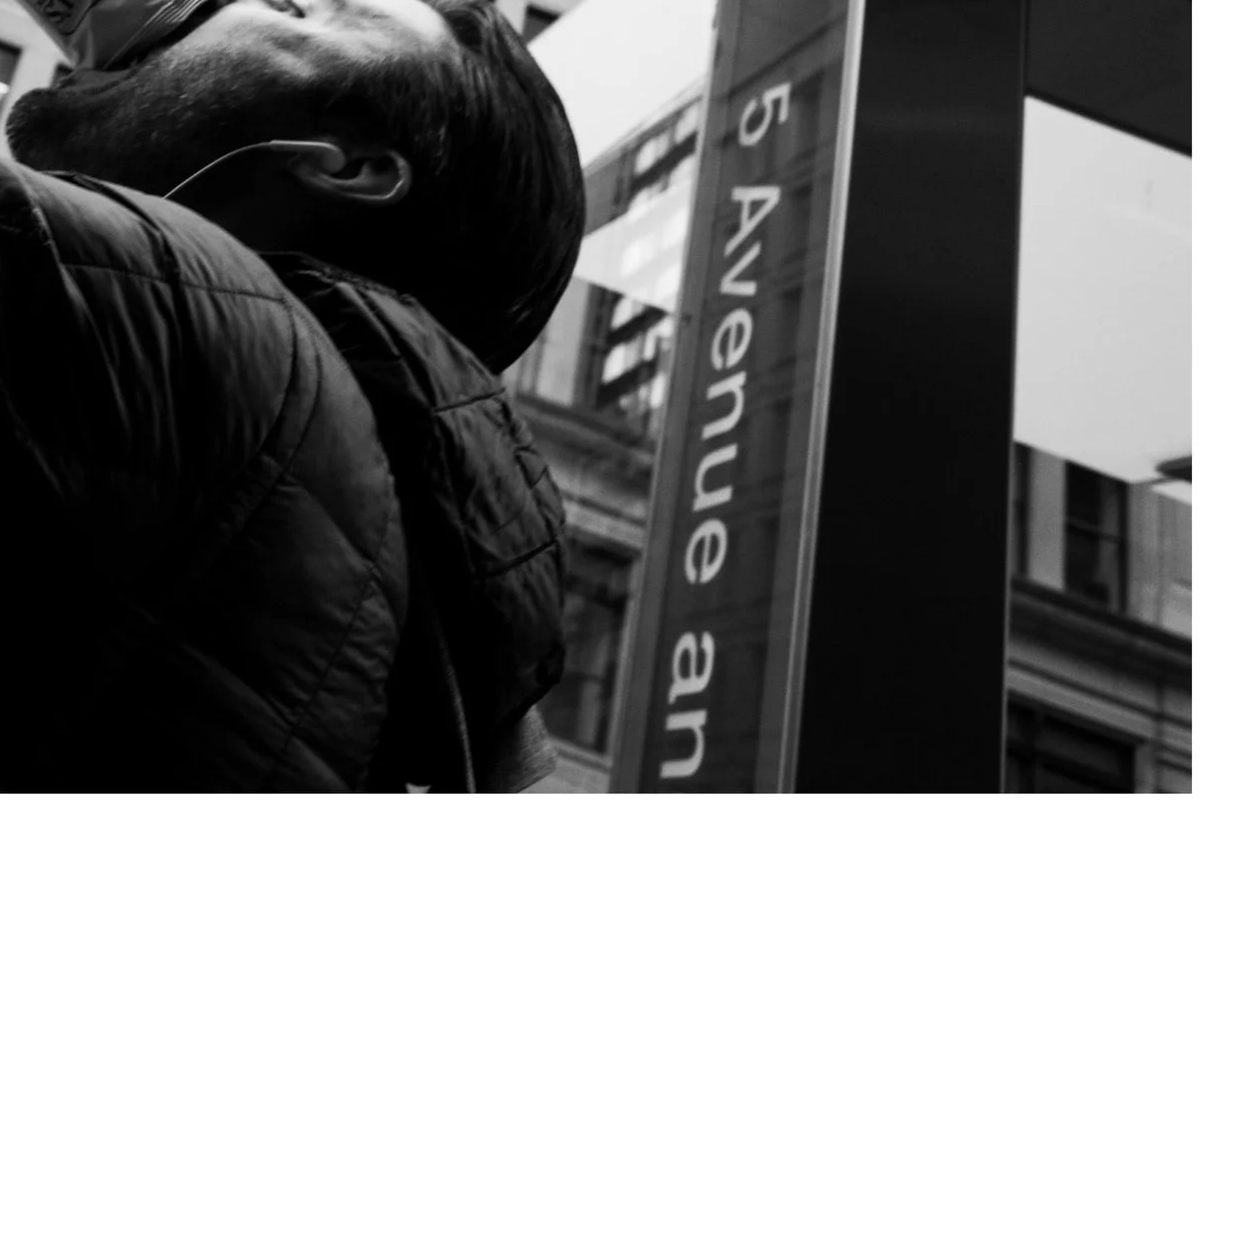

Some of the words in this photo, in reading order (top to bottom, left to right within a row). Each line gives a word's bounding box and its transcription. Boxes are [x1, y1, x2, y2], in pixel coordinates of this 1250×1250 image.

[738, 81, 792, 147] 5
[683, 184, 781, 585] Avenue
[659, 630, 715, 780] an
